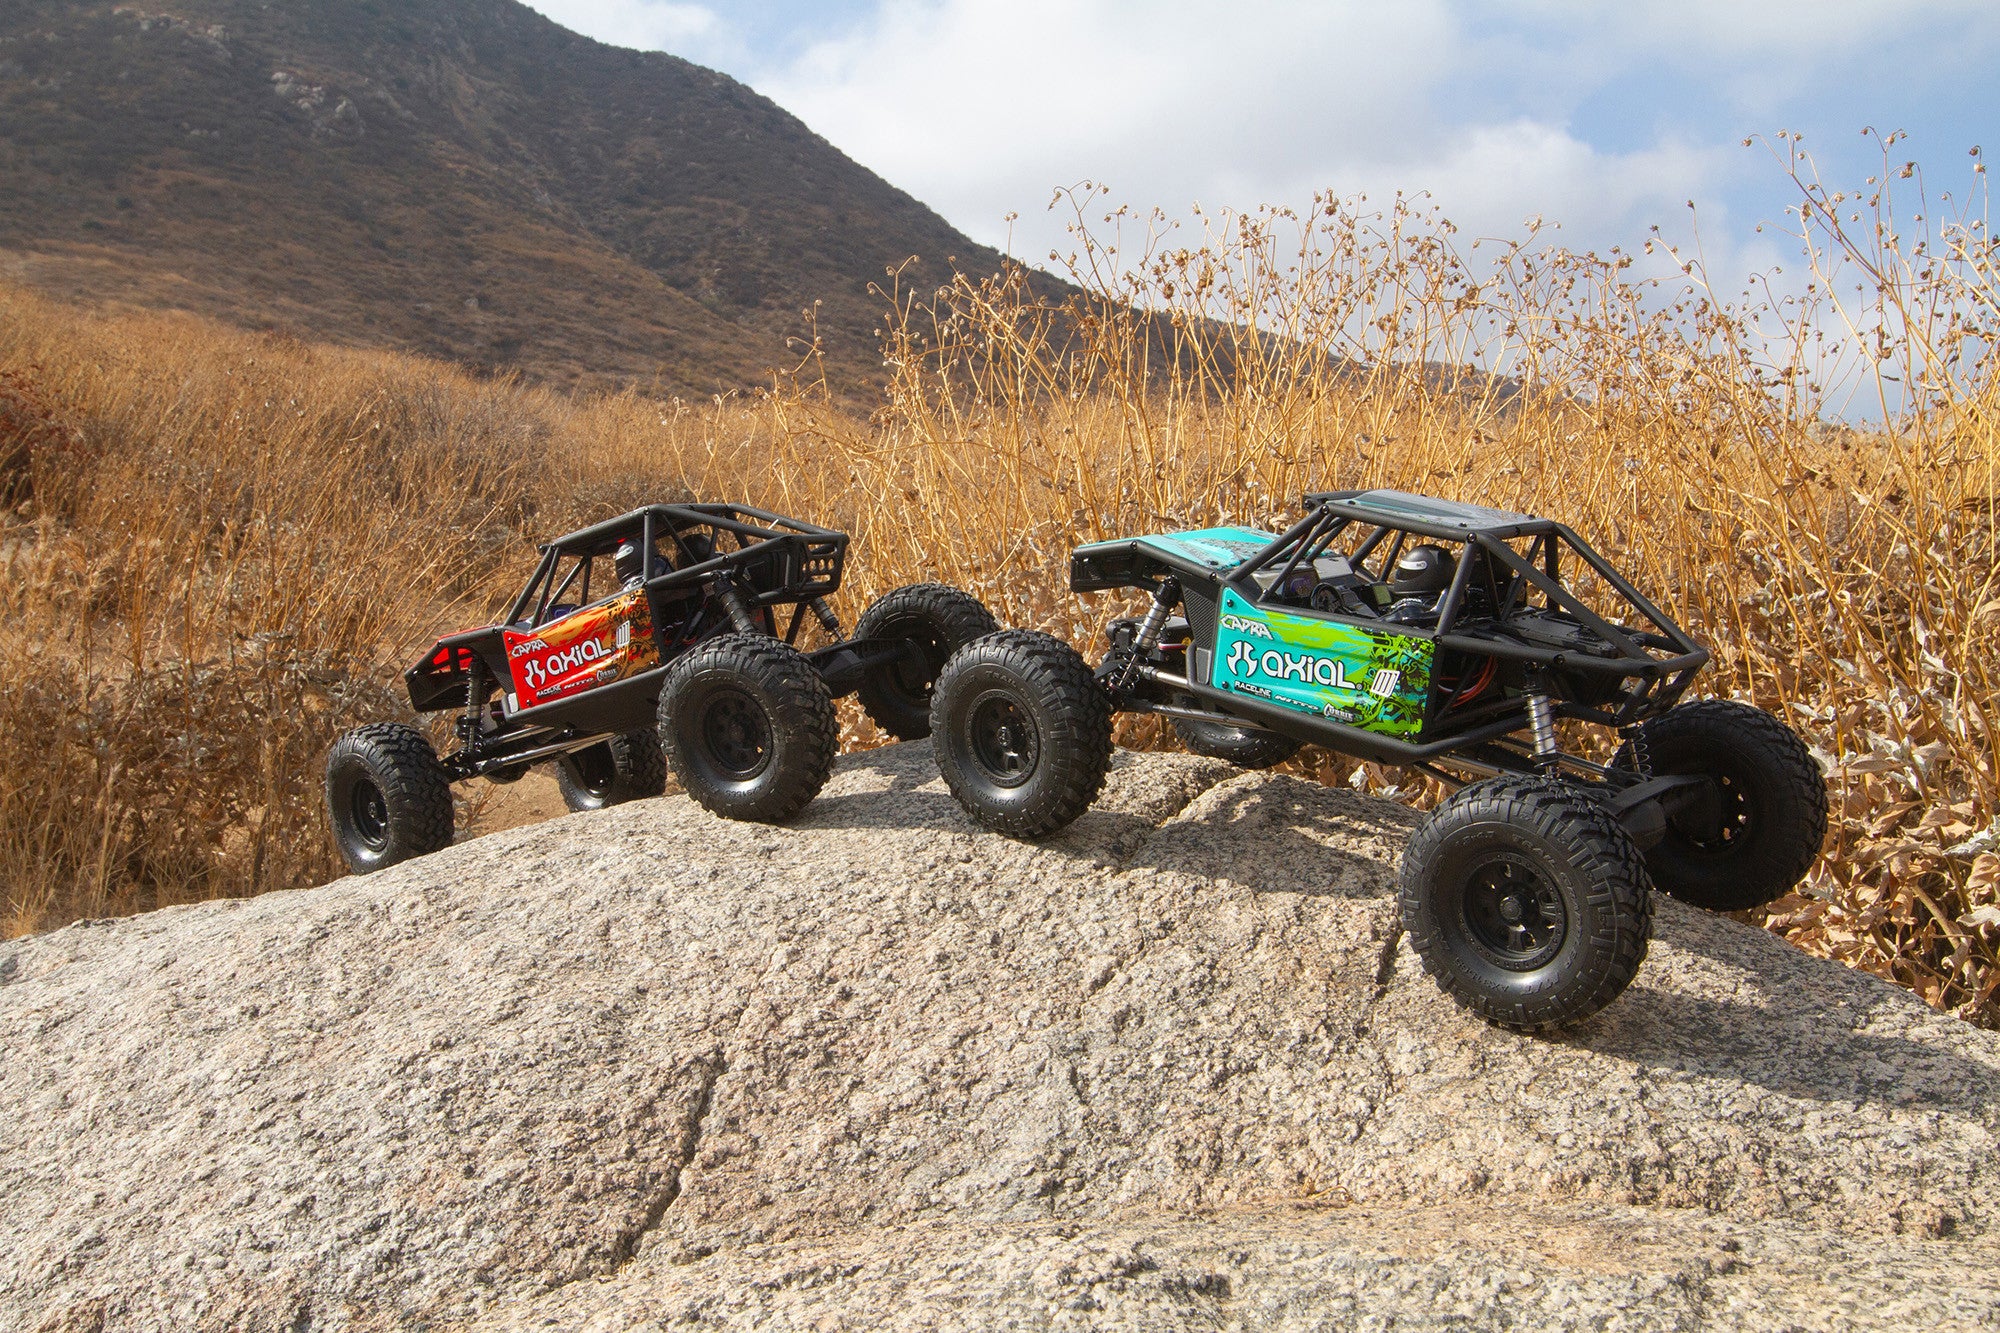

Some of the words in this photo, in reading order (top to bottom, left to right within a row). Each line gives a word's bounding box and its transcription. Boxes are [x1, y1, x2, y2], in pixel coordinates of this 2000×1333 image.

[1220, 614, 1273, 641] CAPRA
[511, 638, 549, 658] CAPRA
[1234, 680, 1272, 697] RACELINE
